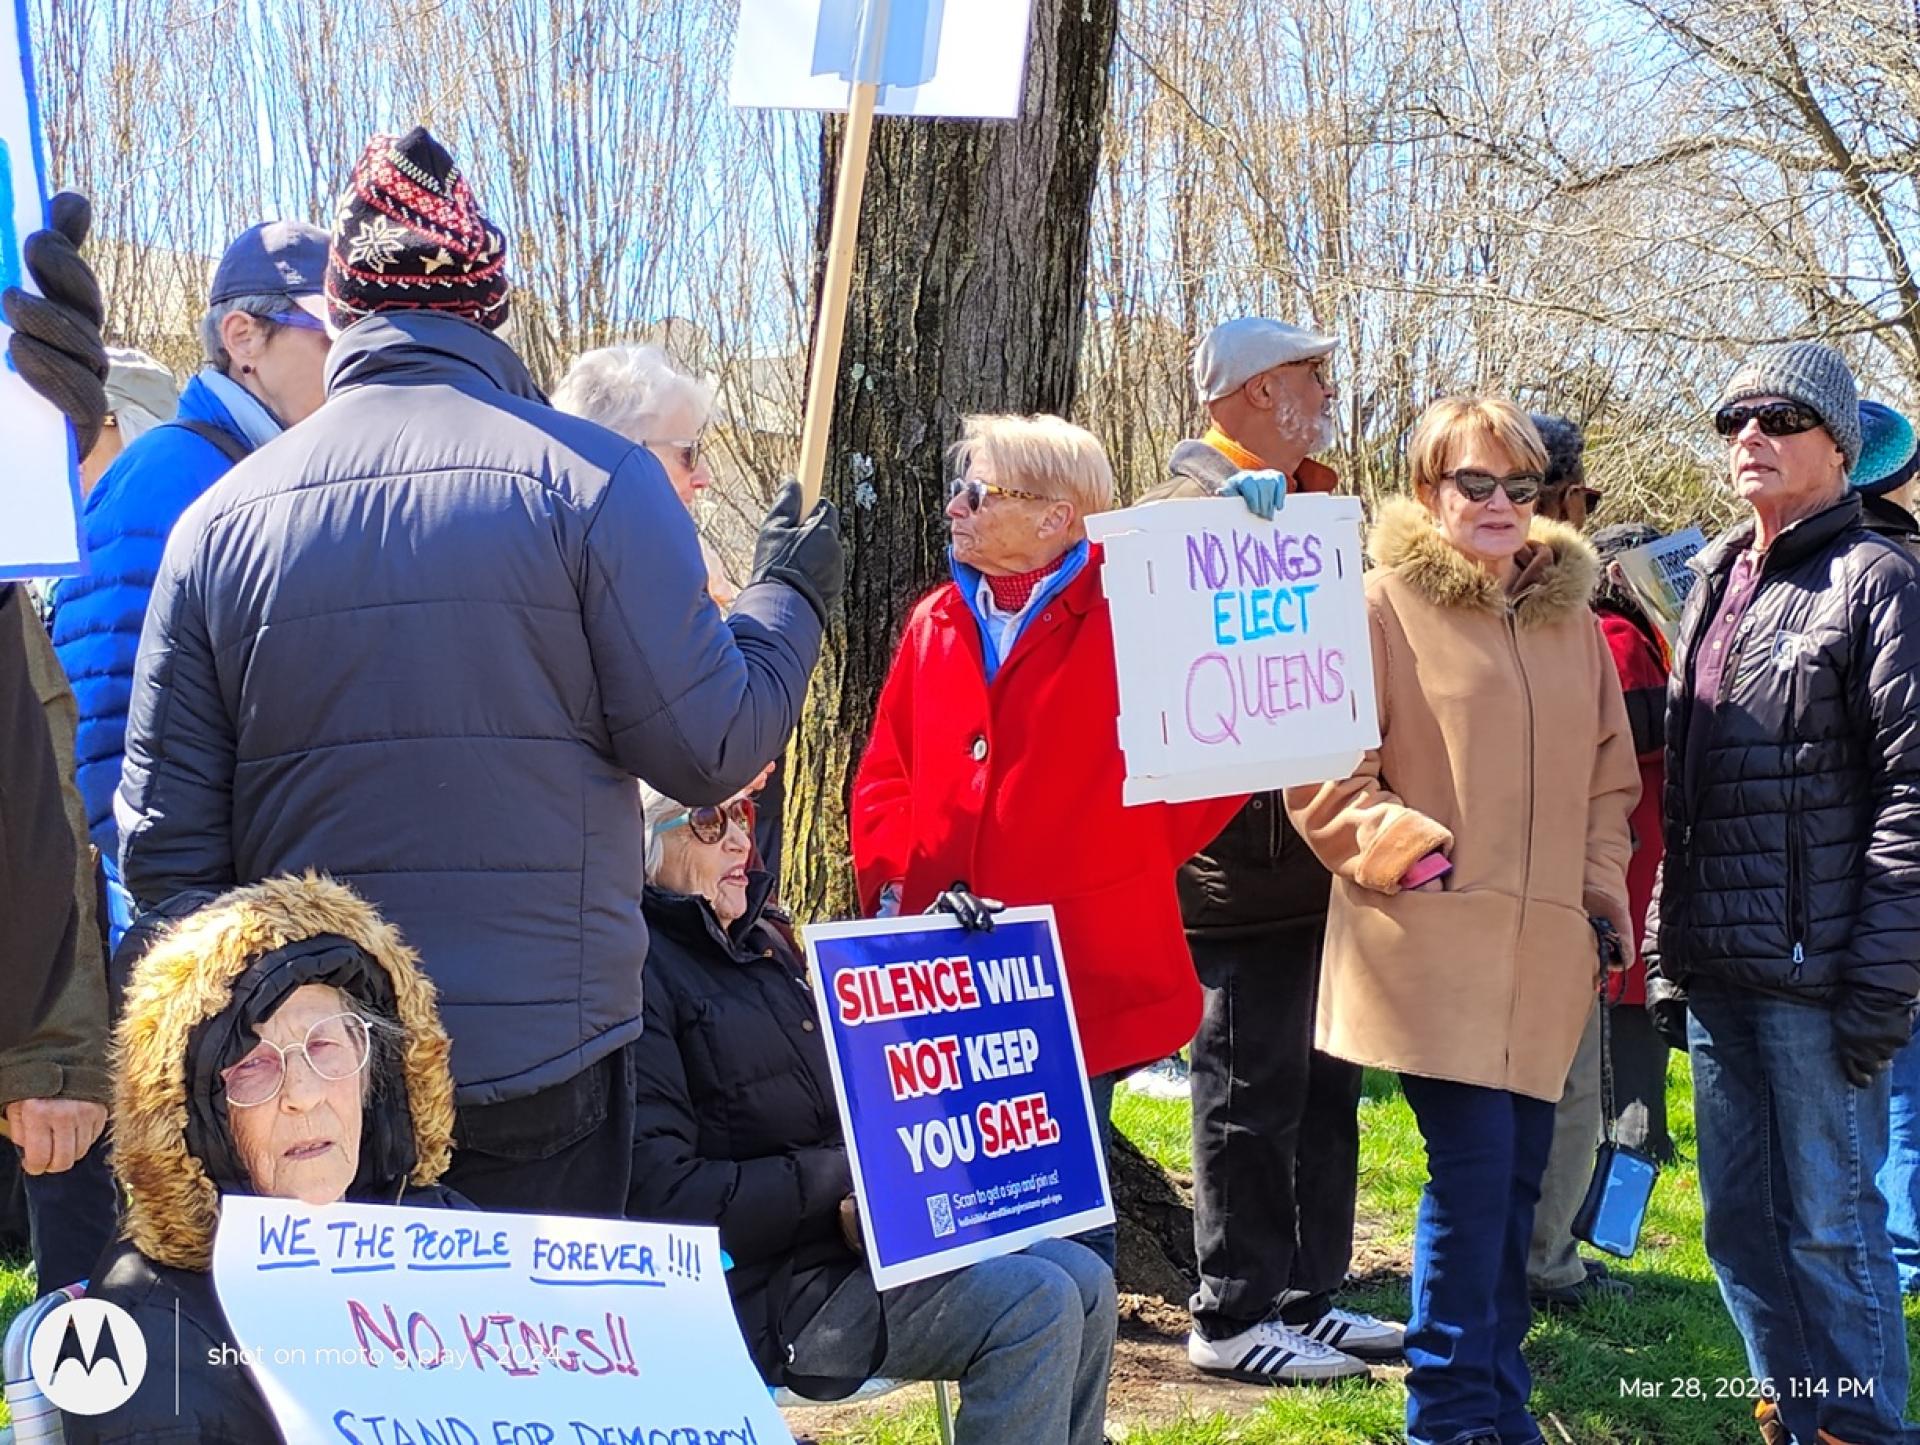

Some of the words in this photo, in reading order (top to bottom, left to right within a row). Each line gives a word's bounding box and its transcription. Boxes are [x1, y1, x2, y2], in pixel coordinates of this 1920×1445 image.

[1186, 532, 1229, 590] NO
[1233, 529, 1322, 587] KINGS
[1214, 583, 1319, 645] ELECT
[1186, 649, 1344, 744] QUEENS
[835, 956, 980, 1026] SILENCE
[977, 955, 1055, 1004] WILL
[885, 1035, 963, 1101] NOT
[964, 1028, 1039, 1082] KEEP
[896, 1114, 975, 1173] YOU
[977, 1092, 1060, 1159] SAFE.
[952, 1193, 977, 1210] Scan
[975, 1189, 986, 1204] to
[986, 1185, 1000, 1206] get
[1005, 1180, 1021, 1200] sign
[1020, 1174, 1035, 1193] and
[260, 1214, 316, 1256] WE
[327, 1221, 395, 1259] THE
[404, 1222, 509, 1261] PEOPLE
[534, 1237, 656, 1277] FOREVER
[347, 1299, 445, 1371] NO
[459, 1311, 639, 1377] KINGS!!
